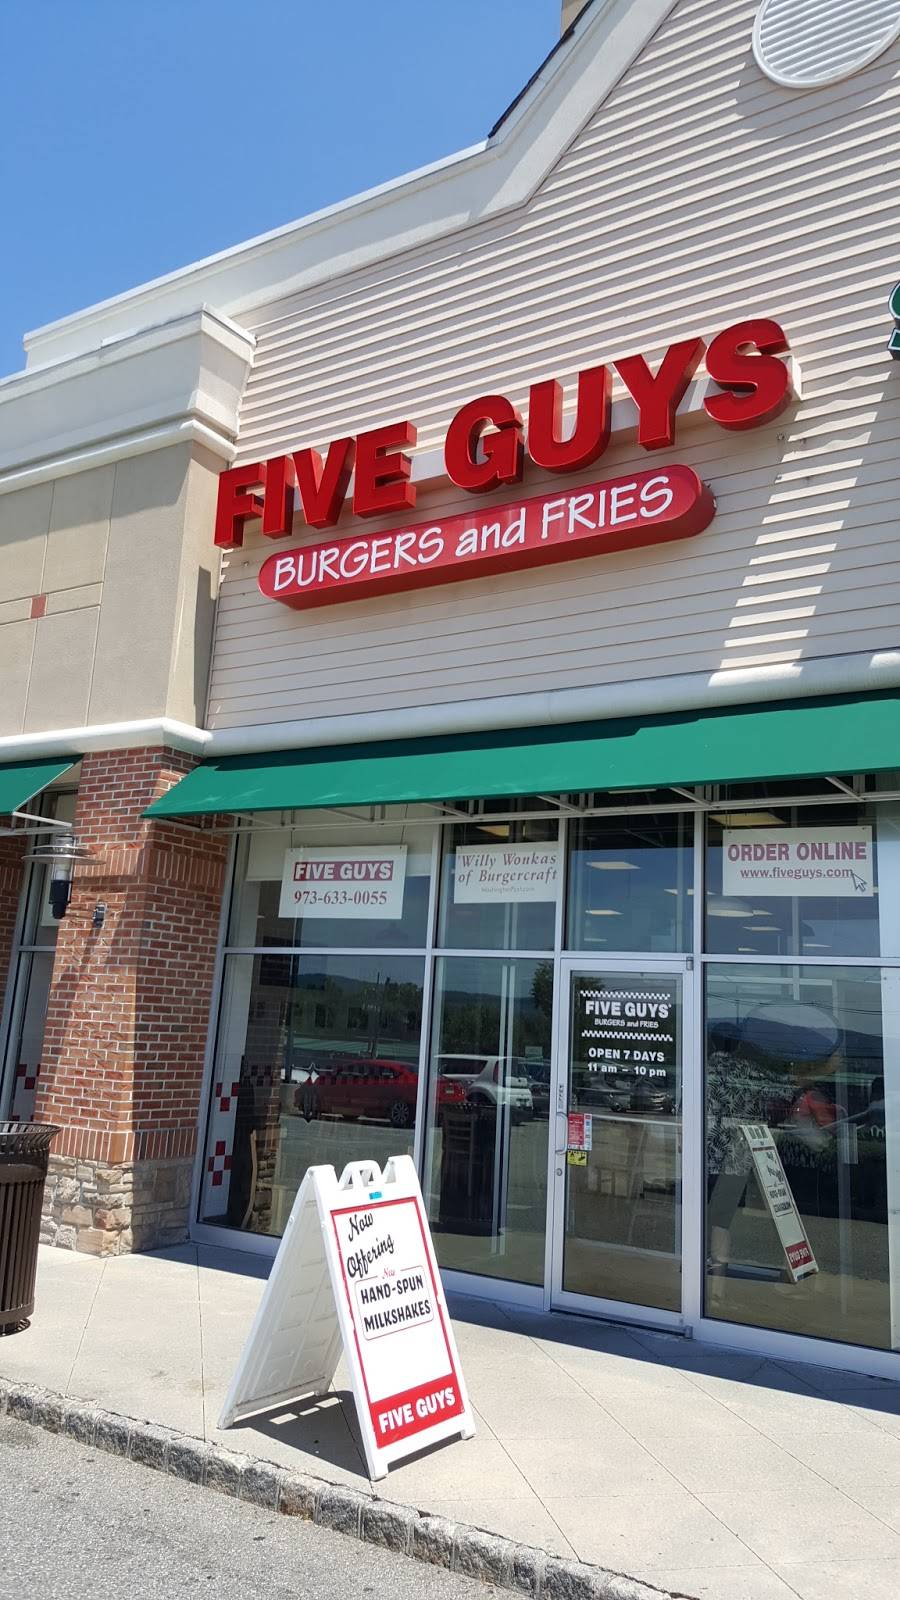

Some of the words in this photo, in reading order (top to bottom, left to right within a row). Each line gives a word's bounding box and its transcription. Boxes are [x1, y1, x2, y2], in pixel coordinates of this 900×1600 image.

[214, 420, 417, 549] FIVE
[444, 318, 792, 493] GUYS
[273, 526, 444, 591] BURGERS
[455, 515, 525, 557] and
[540, 475, 674, 540] FRIES
[727, 843, 790, 862] ORDER
[796, 841, 867, 861] ONLINE
[294, 863, 335, 879] FIVE
[339, 862, 391, 879] GUYS
[458, 870, 473, 886] of
[479, 866, 558, 885] Burgercraft
[740, 866, 854, 880] www.fiveguys.com
[293, 890, 388, 905] 973-633-0055
[585, 1000, 621, 1016] FIVE
[624, 1002, 669, 1019] GUYS
[594, 1018, 625, 1027] BURGERS
[626, 1020, 639, 1028] and
[588, 1047, 620, 1059] OPEN
[623, 1050, 631, 1060] 7
[633, 1051, 665, 1062] DAYS
[588, 1062, 598, 1072] 11
[601, 1065, 617, 1073] am
[634, 1066, 647, 1075] 10
[649, 1068, 666, 1077] pm
[348, 1212, 374, 1242] Now
[347, 1234, 395, 1278] Offering
[360, 1275, 424, 1304] HAND-SPUN
[363, 1299, 431, 1332] MILKSHAKES
[378, 1403, 415, 1434] FIVE
[415, 1386, 456, 1418] GUYS
